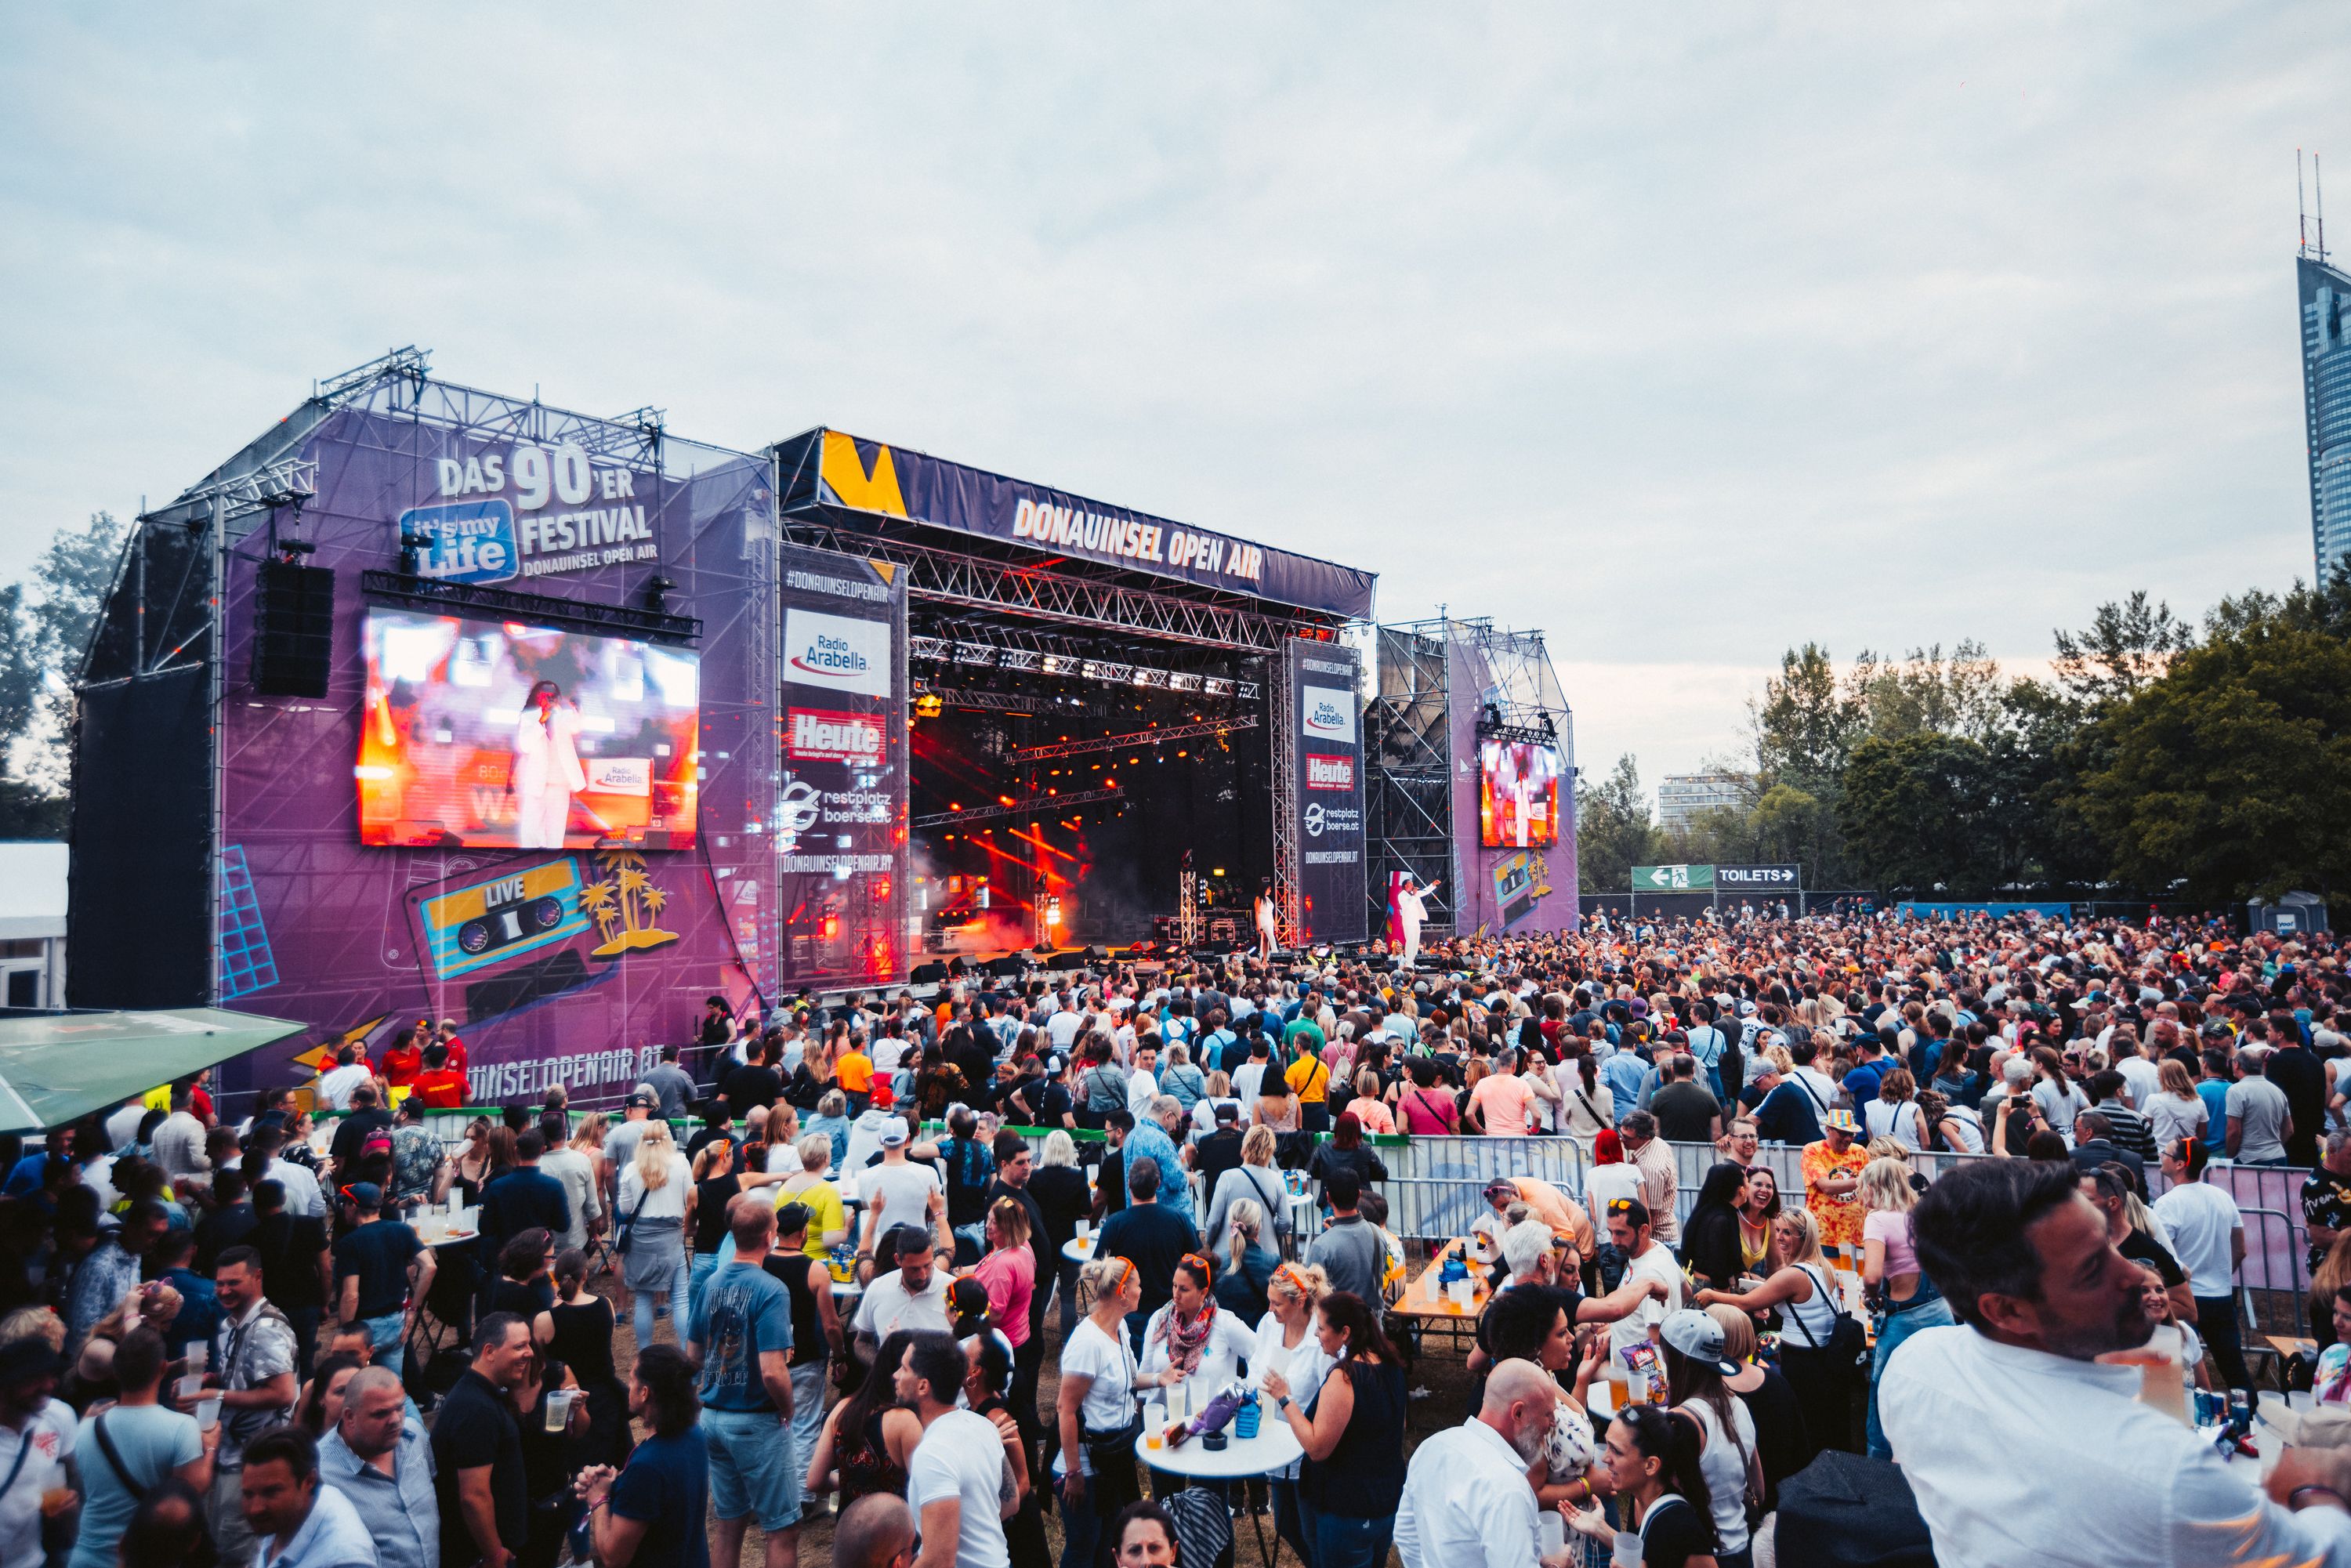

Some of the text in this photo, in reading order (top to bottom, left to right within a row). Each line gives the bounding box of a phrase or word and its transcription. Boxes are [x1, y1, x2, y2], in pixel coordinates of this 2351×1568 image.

[439, 455, 505, 496] DAS
[460, 517, 500, 538] my
[521, 505, 652, 555] FESTIVAL
[1013, 499, 1262, 580] DONAUINSEL OPEN AIR
[417, 537, 506, 578] Life
[524, 544, 658, 577] DONAUINSEL OPEN AIR
[787, 570, 889, 603] #DONAUINSELOPENAIR
[818, 636, 848, 651] Radio
[1319, 703, 1335, 712] Radio
[795, 714, 880, 753] Heute
[1310, 759, 1350, 783] Heute
[824, 790, 892, 806] restplatz
[824, 806, 892, 823] boerse.at
[1326, 807, 1359, 820] restplatz
[1326, 820, 1359, 831] boerse.at
[1506, 860, 1516, 873] LIVE
[1719, 869, 1780, 882] TOILETS
[486, 877, 525, 907] LIVE
